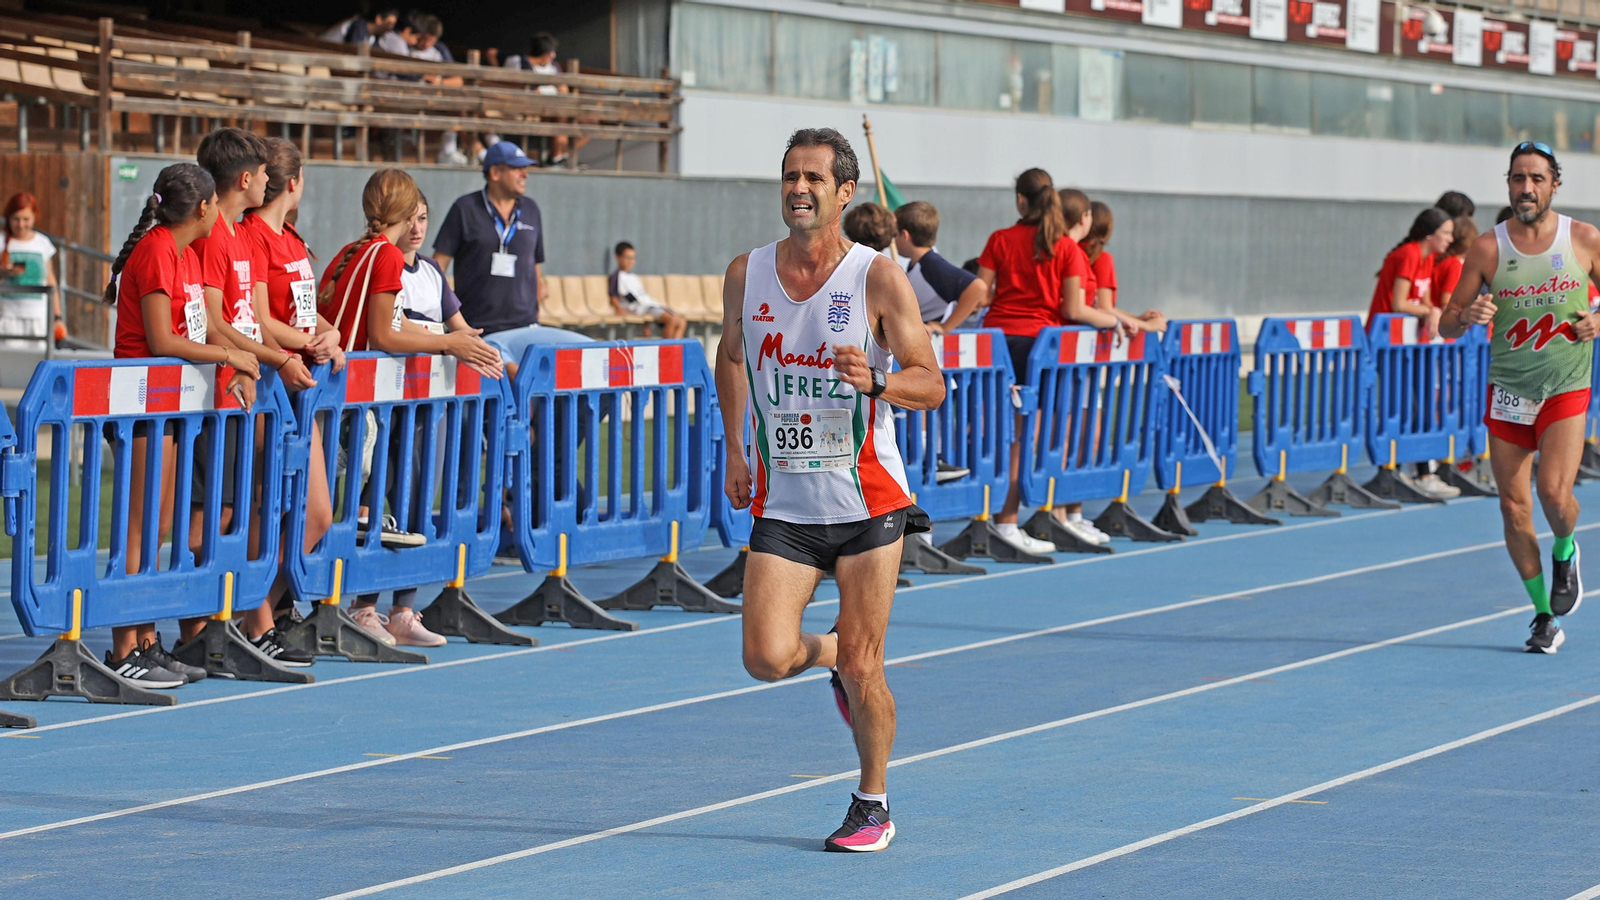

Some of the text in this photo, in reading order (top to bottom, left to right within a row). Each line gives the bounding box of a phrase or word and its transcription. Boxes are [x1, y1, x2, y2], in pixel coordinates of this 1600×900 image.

[1498, 274, 1581, 298] maratón
[1514, 295, 1567, 309] JEREZ
[756, 332, 834, 371] Marato
[1497, 389, 1520, 407] 368
[775, 427, 814, 450] 936
